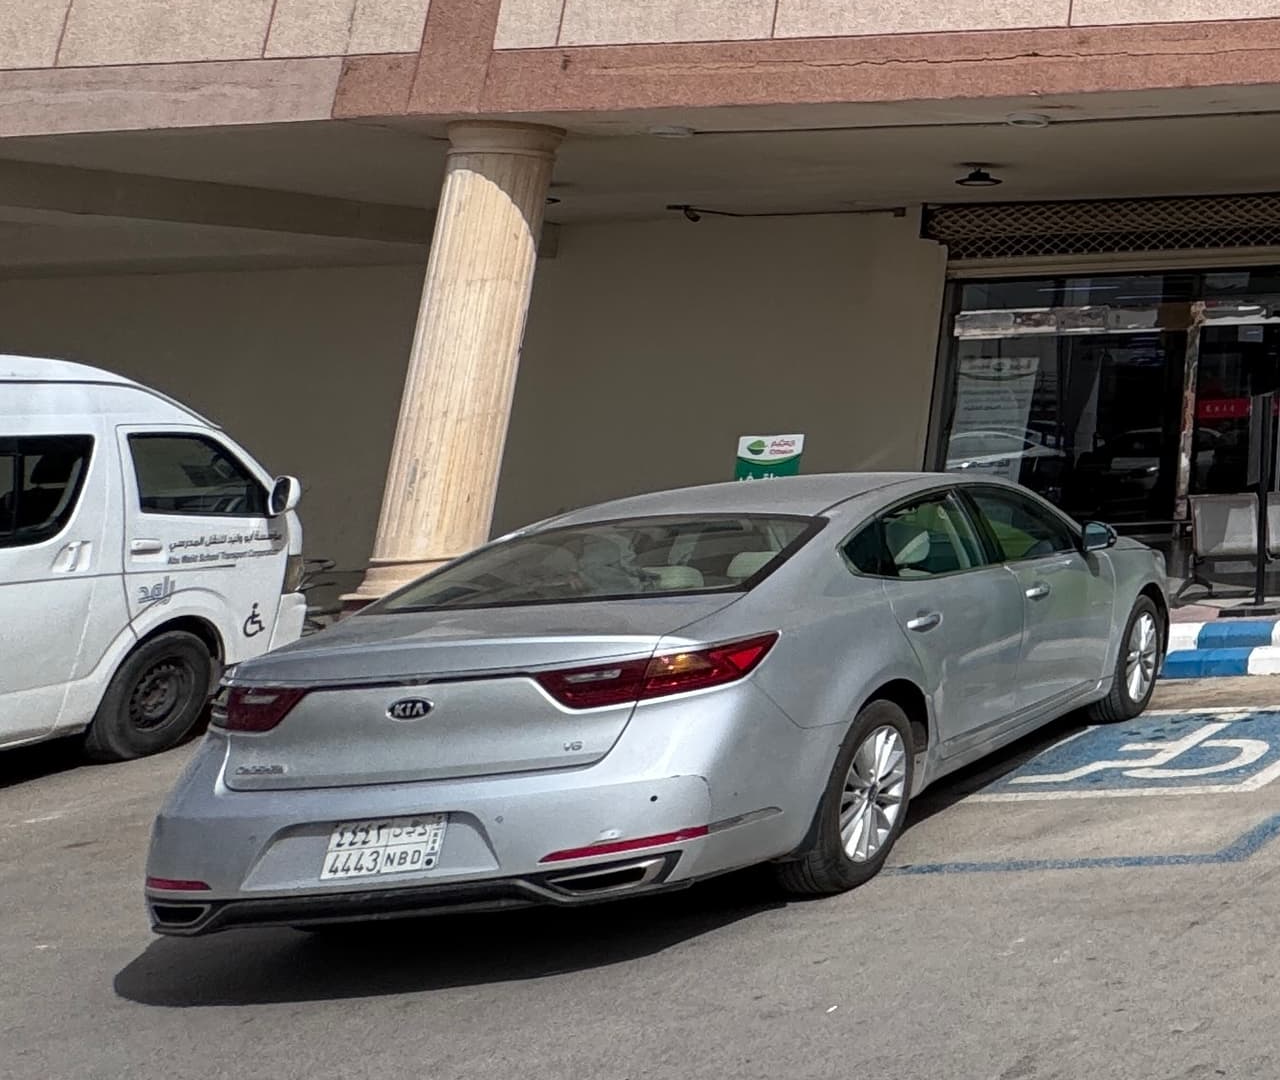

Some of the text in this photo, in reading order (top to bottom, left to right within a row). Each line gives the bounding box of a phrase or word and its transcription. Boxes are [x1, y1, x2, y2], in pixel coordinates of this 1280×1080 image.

[393, 702, 426, 718] KIA
[328, 850, 380, 875] 4443
[384, 849, 422, 867] NBD
